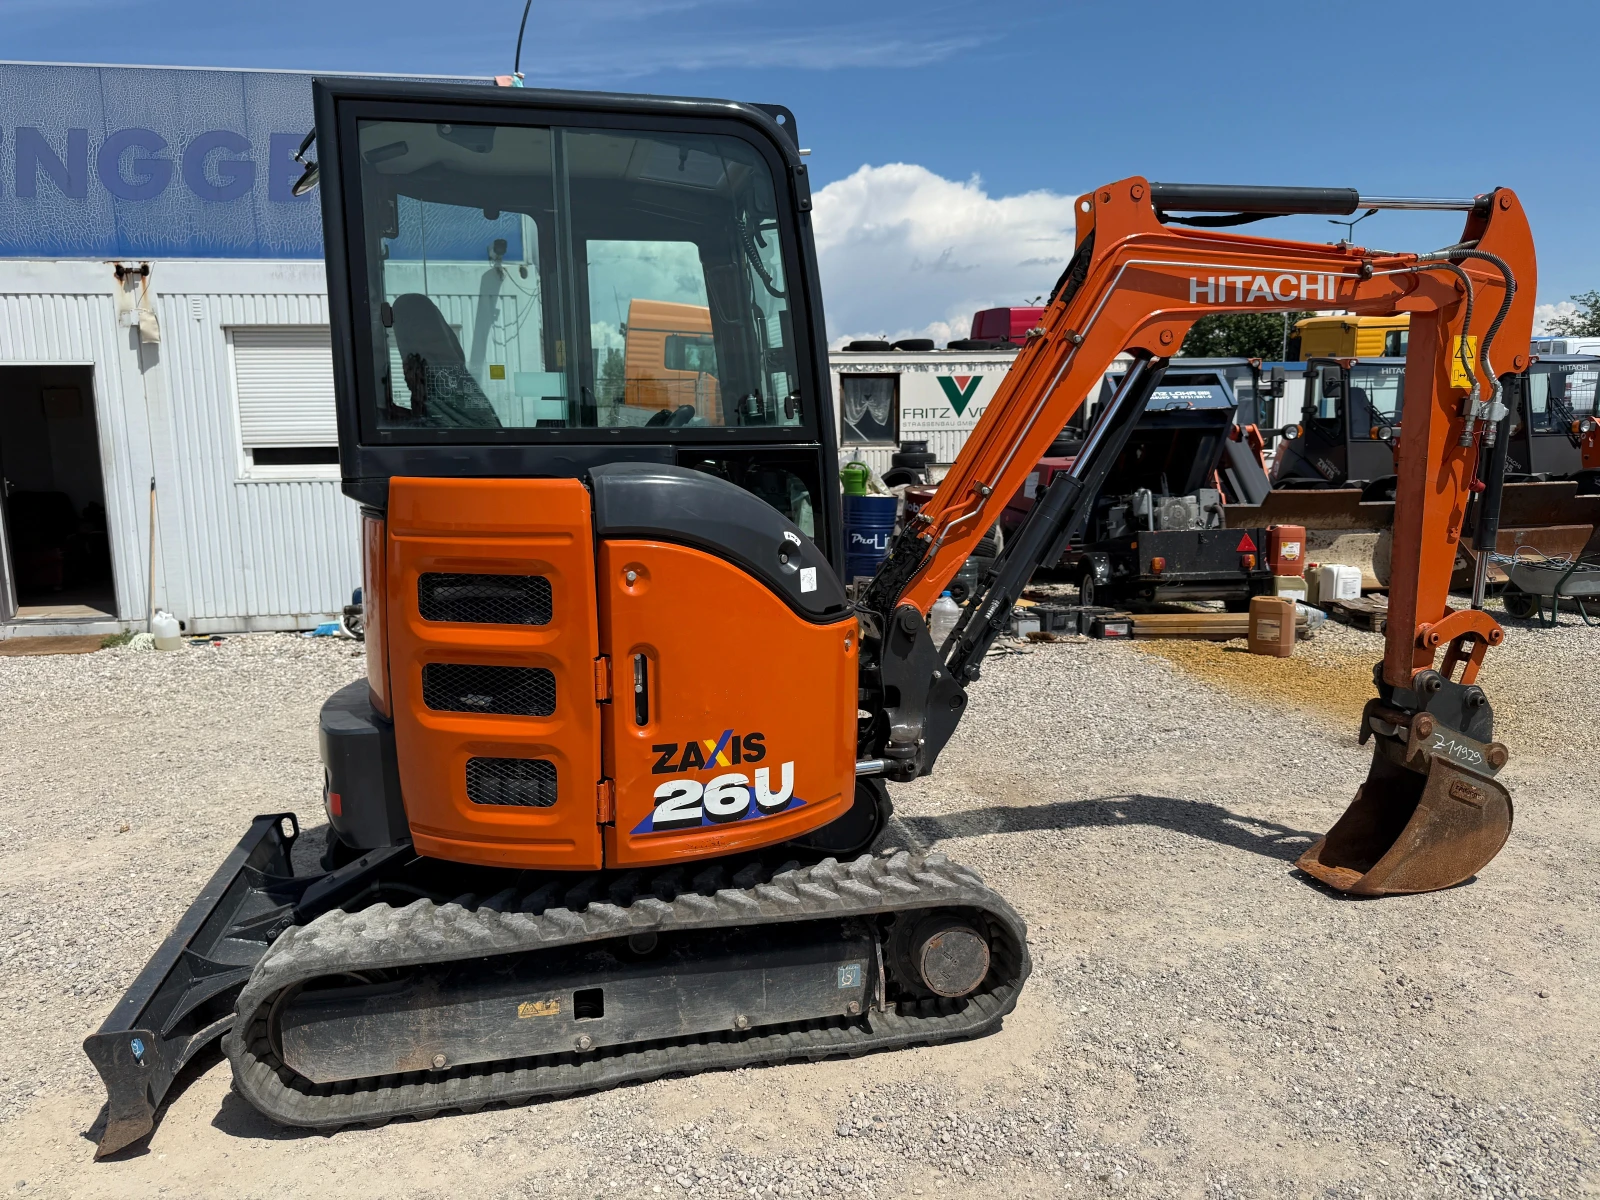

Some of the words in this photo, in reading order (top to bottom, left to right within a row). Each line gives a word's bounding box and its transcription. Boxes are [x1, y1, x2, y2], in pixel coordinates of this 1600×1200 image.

[0, 127, 312, 201] NGGE
[1189, 274, 1335, 304] HITACHI
[902, 407, 951, 419] FRITZ
[902, 420, 955, 428] STRASSENBAU
[652, 729, 767, 775] ZAXIS
[652, 761, 794, 831] 26U
